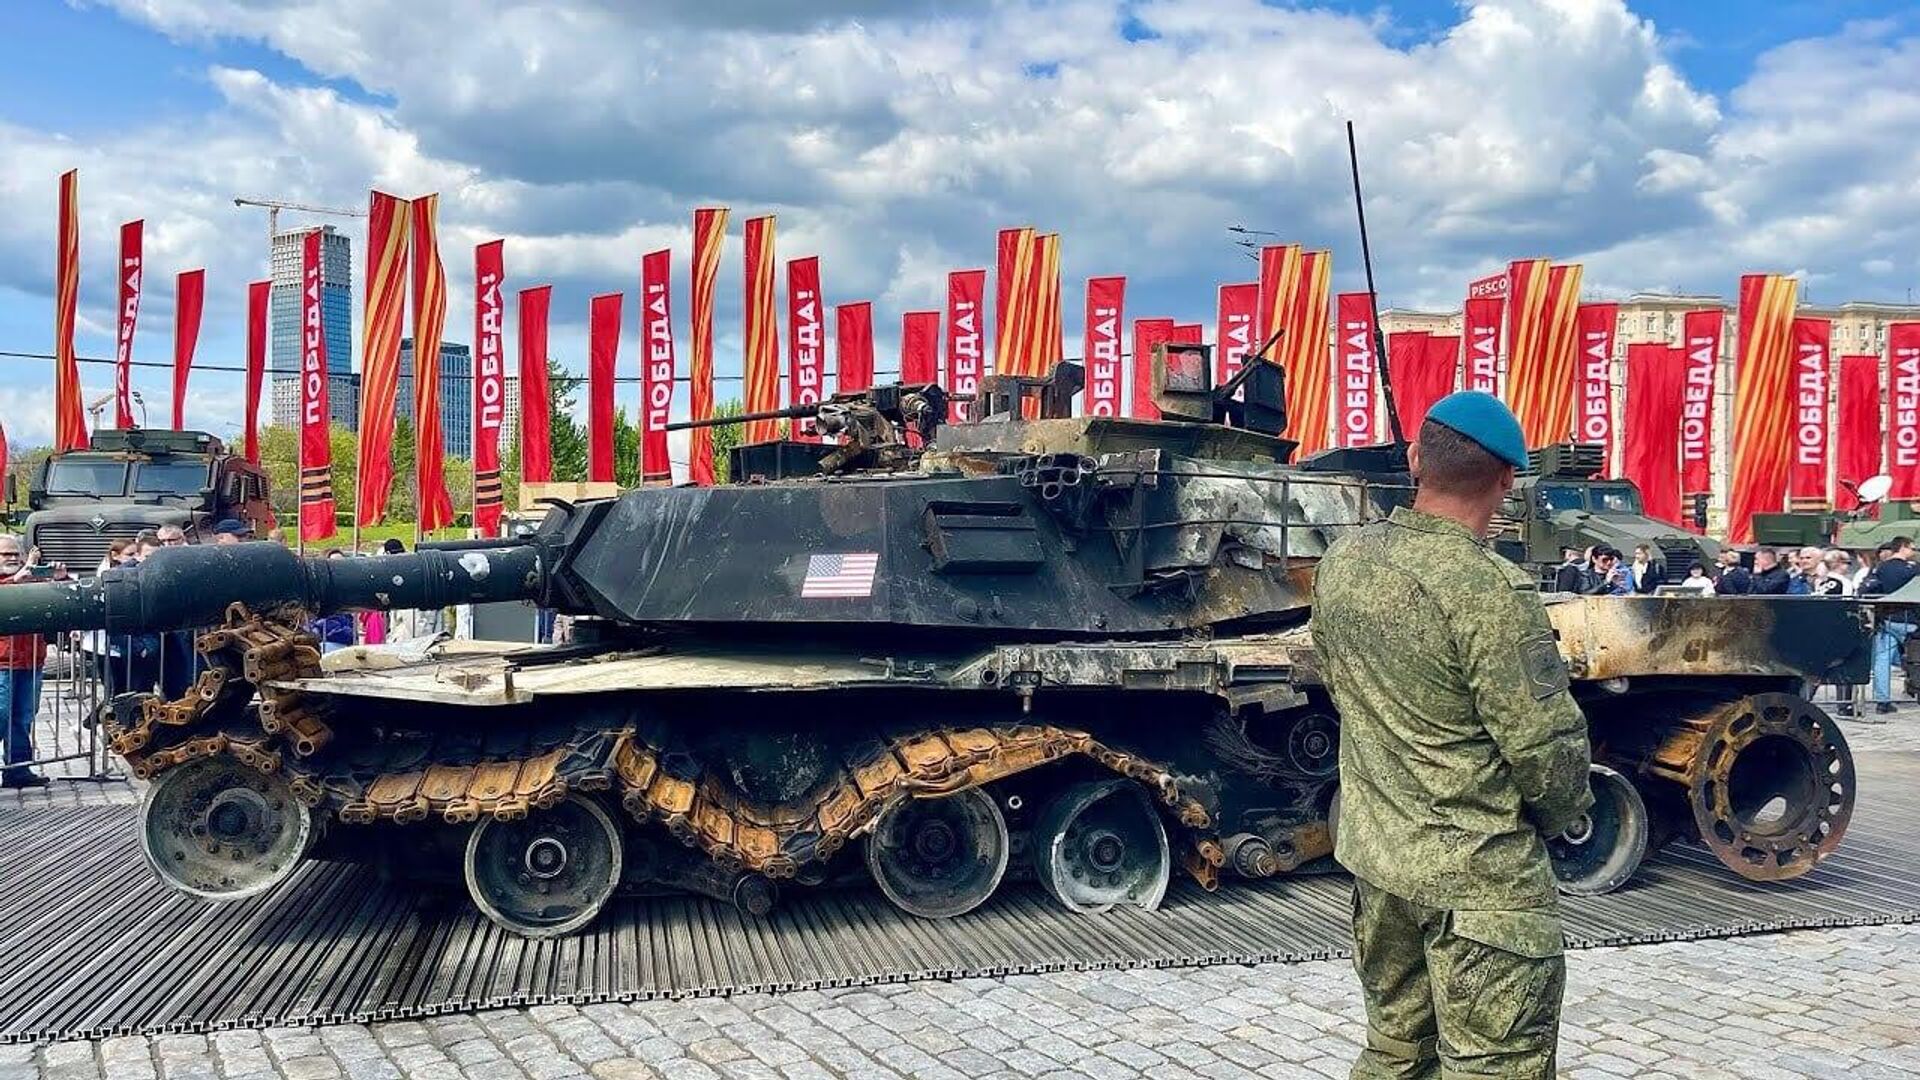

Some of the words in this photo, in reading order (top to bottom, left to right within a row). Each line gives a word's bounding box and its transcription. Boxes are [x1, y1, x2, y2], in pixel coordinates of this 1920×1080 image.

[306, 268, 322, 424] ПОБЕДА!
[481, 273, 501, 428] ПОБЕДА!
[649, 283, 671, 432] ПОБЕДА!
[1094, 308, 1119, 417] ОБЕДА!
[1585, 332, 1609, 457] ОБЕДА!
[1684, 337, 1714, 459] ПОБЕДА!
[1798, 344, 1826, 465] ПОБЕДА!
[1896, 348, 1920, 466] ПОБЕДА!
